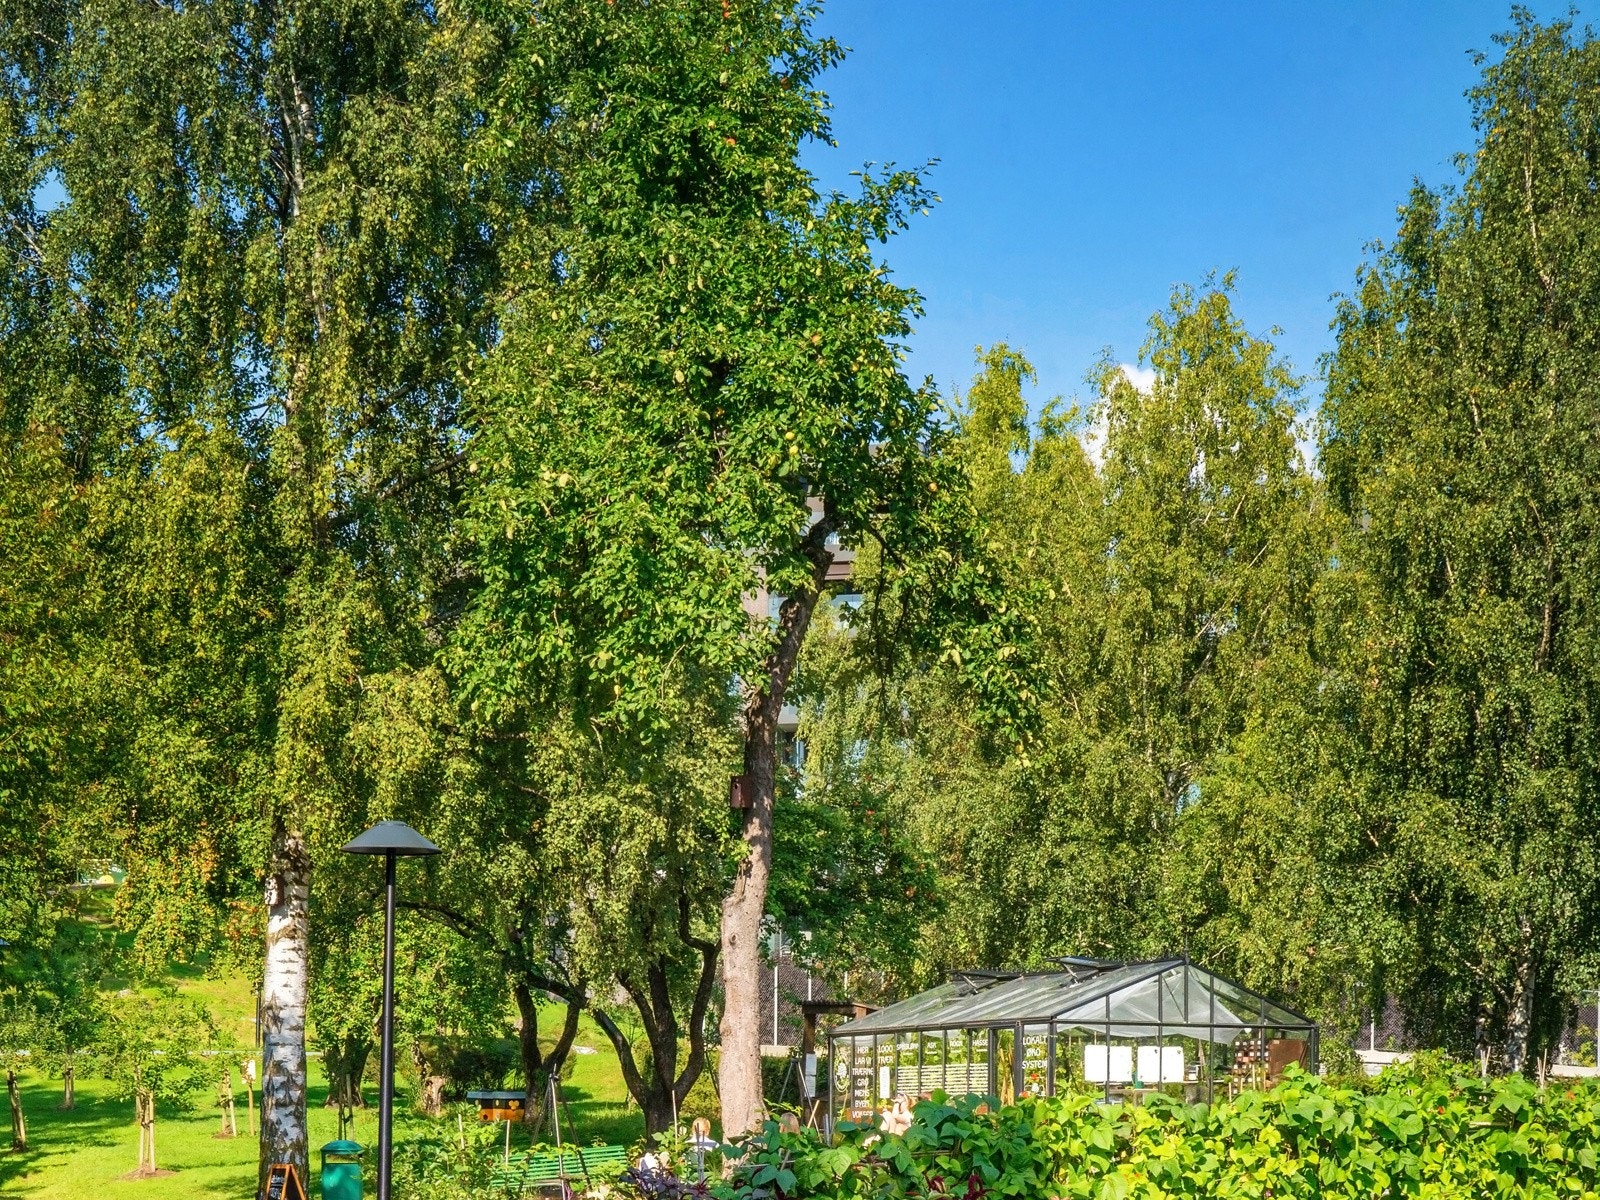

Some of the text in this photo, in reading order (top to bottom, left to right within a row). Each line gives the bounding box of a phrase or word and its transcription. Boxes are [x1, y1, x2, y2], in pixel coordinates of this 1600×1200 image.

[1022, 1035, 1047, 1044] LOKALT
[1026, 1048, 1041, 1057] ØKO
[854, 1057, 865, 1065] LAR
[1022, 1060, 1048, 1069] SYSTEM
